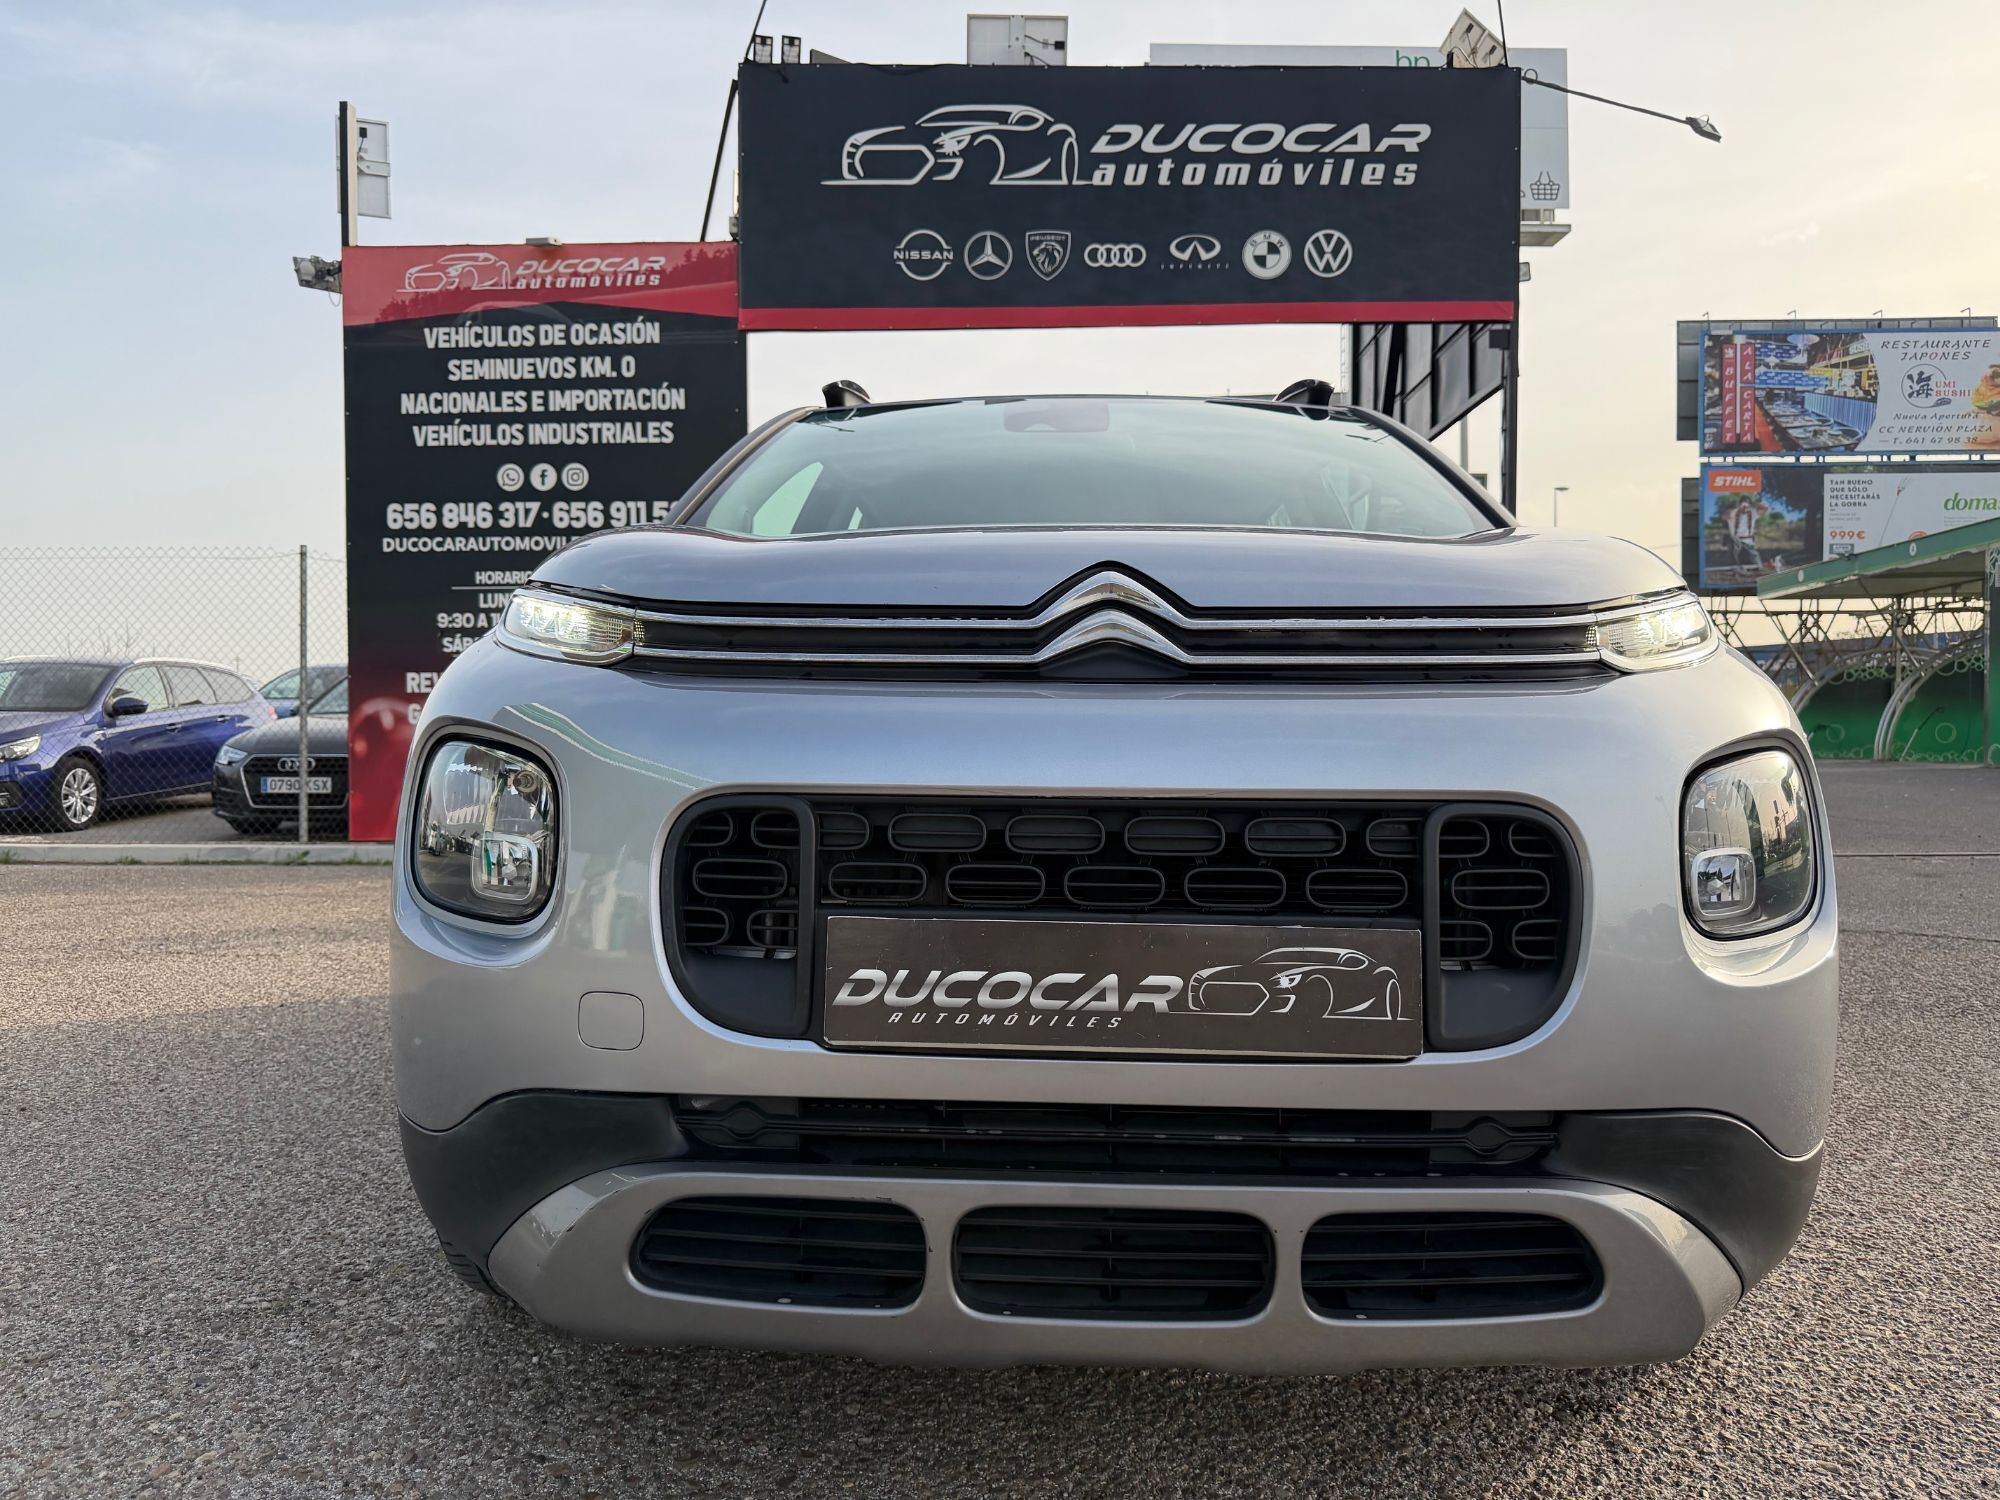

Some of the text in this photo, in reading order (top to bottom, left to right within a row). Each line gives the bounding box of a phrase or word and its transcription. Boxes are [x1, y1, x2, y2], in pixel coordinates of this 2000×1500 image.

[1090, 123, 1432, 154] DUCOCAR
[1091, 156, 1417, 186] automóviles
[894, 250, 953, 260] NISSAN
[515, 256, 666, 275] DUCOCAR
[424, 316, 660, 349] VEHÍCULOS DE OCASIÓN
[1881, 339, 1991, 349] RESTAURANTE
[1901, 351, 1971, 360] JAPONES
[448, 357, 577, 381] SEMINUEVOS
[580, 356, 617, 379] KM.
[401, 382, 686, 415] NACIONALES E IMPORTACIÓN
[1935, 389, 1971, 397] SUSHI
[1725, 367, 1734, 441] BUFFET
[412, 418, 674, 447] VEHÍCULOS INDUSTRIALES
[1956, 425, 1992, 433] PLAZA
[1714, 476, 1756, 486] STIHL
[386, 502, 437, 530] 656
[442, 501, 493, 529] 846
[609, 501, 648, 526] 911
[382, 535, 584, 552] DUCOCARAUTOMOVI
[1830, 530, 1866, 540] 999€
[437, 613, 475, 628] 9:30
[477, 613, 489, 628] A
[442, 633, 480, 653] SÁ
[270, 779, 300, 791] 0790
[831, 968, 1185, 1012] DUCOCAR
[887, 1010, 1122, 1029] AUTOMÓVILES
